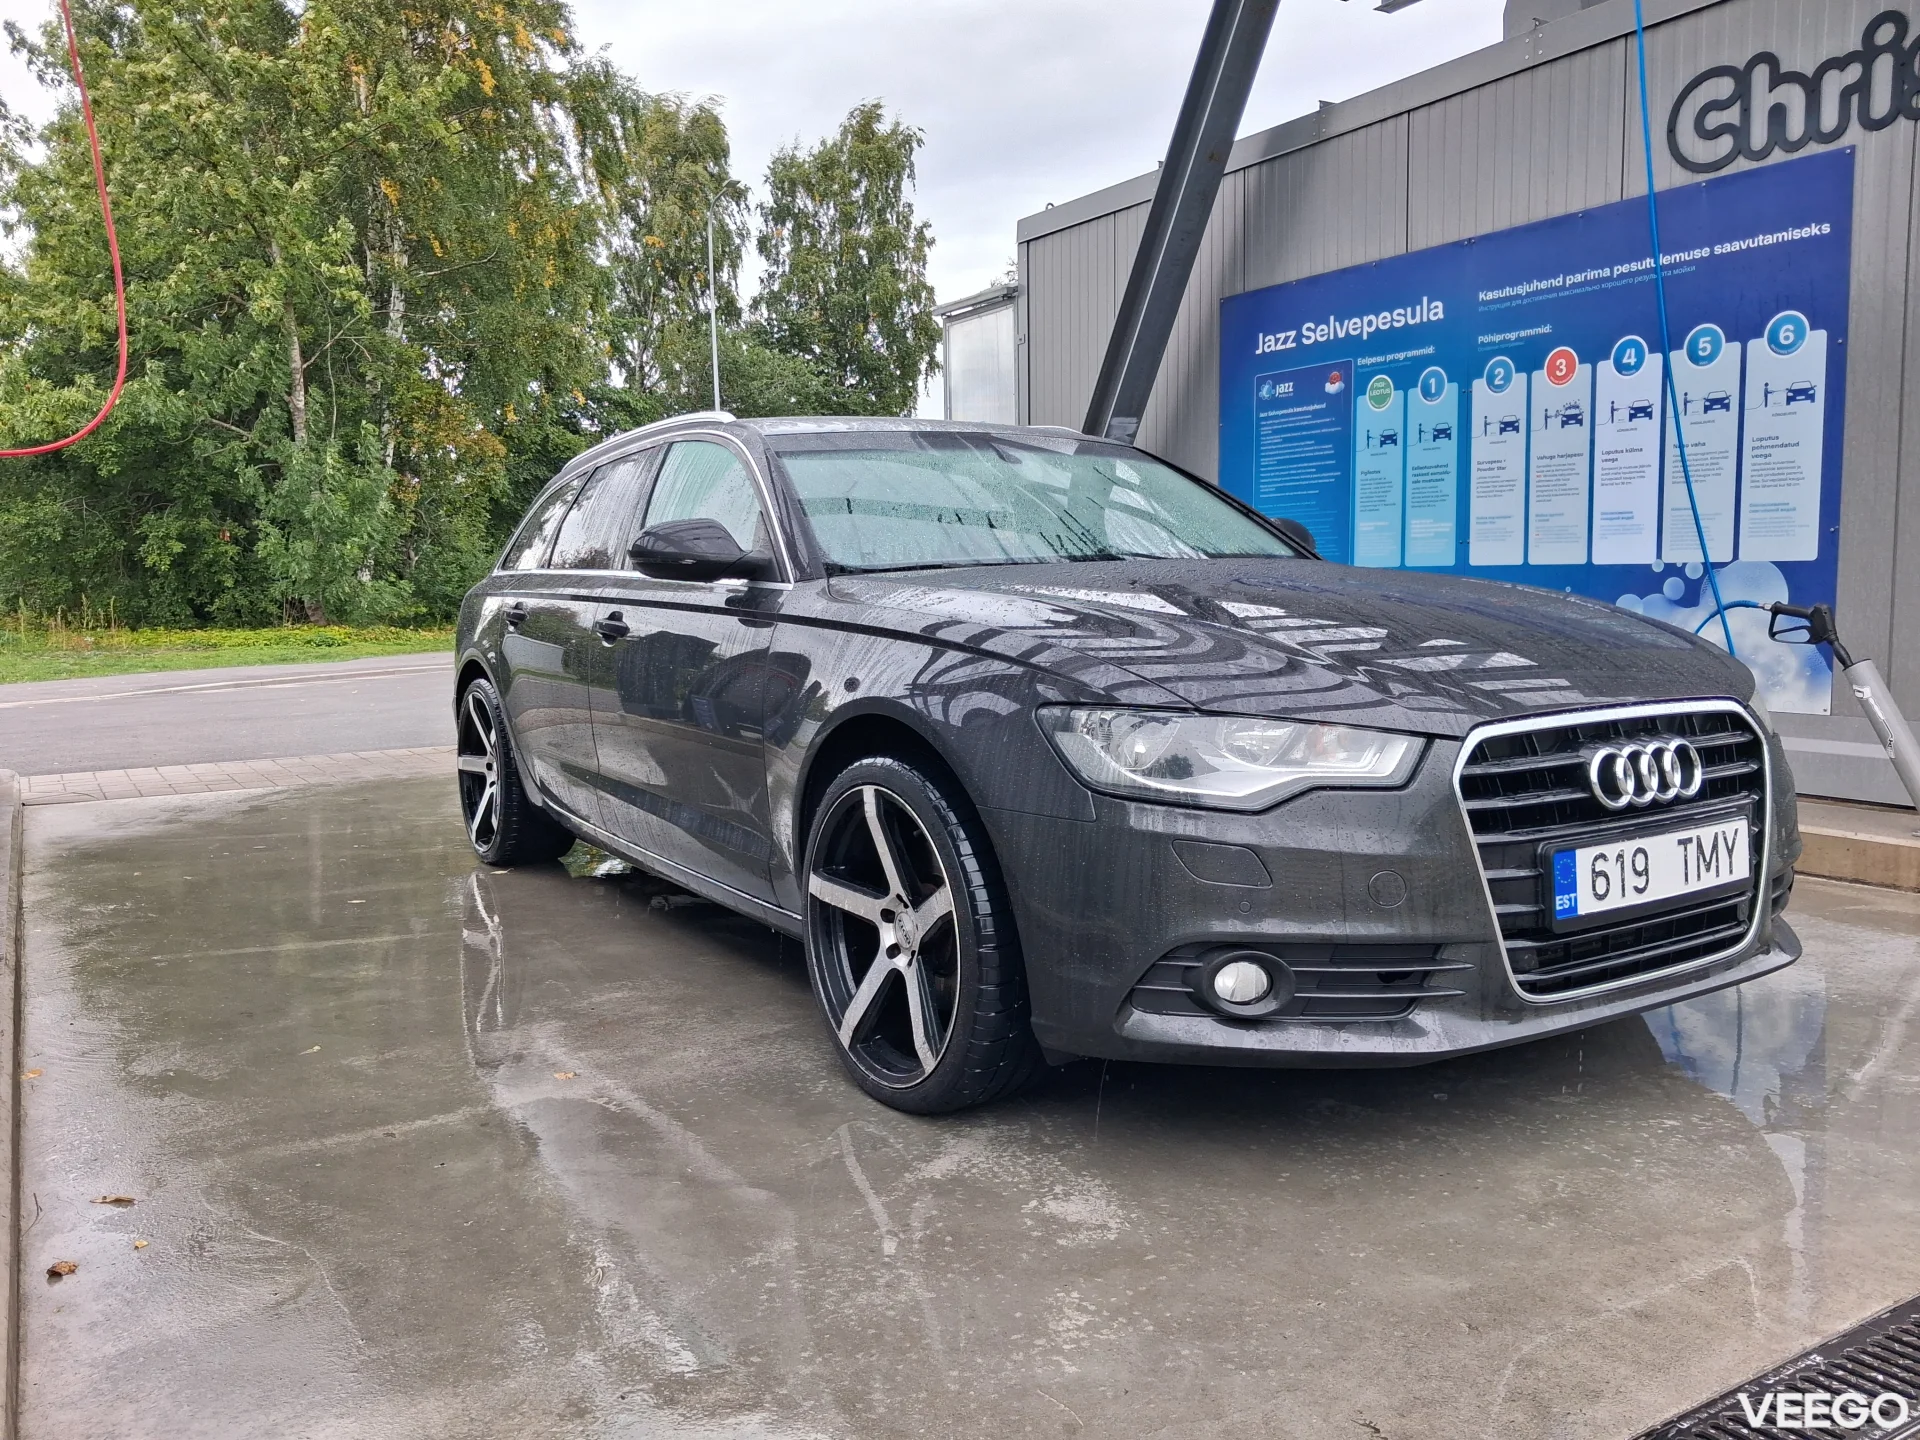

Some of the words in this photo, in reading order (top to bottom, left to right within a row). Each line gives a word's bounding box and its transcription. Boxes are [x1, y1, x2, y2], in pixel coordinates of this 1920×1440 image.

[1478, 274, 1563, 302] Kasutusjuhend
[1566, 266, 1611, 287] parima
[1713, 222, 1831, 255] saavutamiseks
[1601, 277, 1633, 289] хорошего
[1673, 265, 1696, 275] мойки
[1255, 330, 1297, 354] Jazz
[1301, 296, 1445, 345] Selvepesula
[1478, 324, 1553, 344] Põhiprogrammid:
[1779, 324, 1795, 345] 6
[1357, 355, 1385, 366] Eelpesu
[1386, 345, 1435, 363] programmid:
[1622, 347, 1637, 366] 4
[1698, 336, 1712, 357] 5
[1494, 367, 1505, 385] 2
[1555, 358, 1567, 377] 3
[1429, 377, 1436, 394] 1
[1752, 435, 1780, 443] Loputus
[1591, 846, 1650, 901] 619
[1677, 827, 1740, 886] TMY
[1556, 892, 1577, 911] EST
